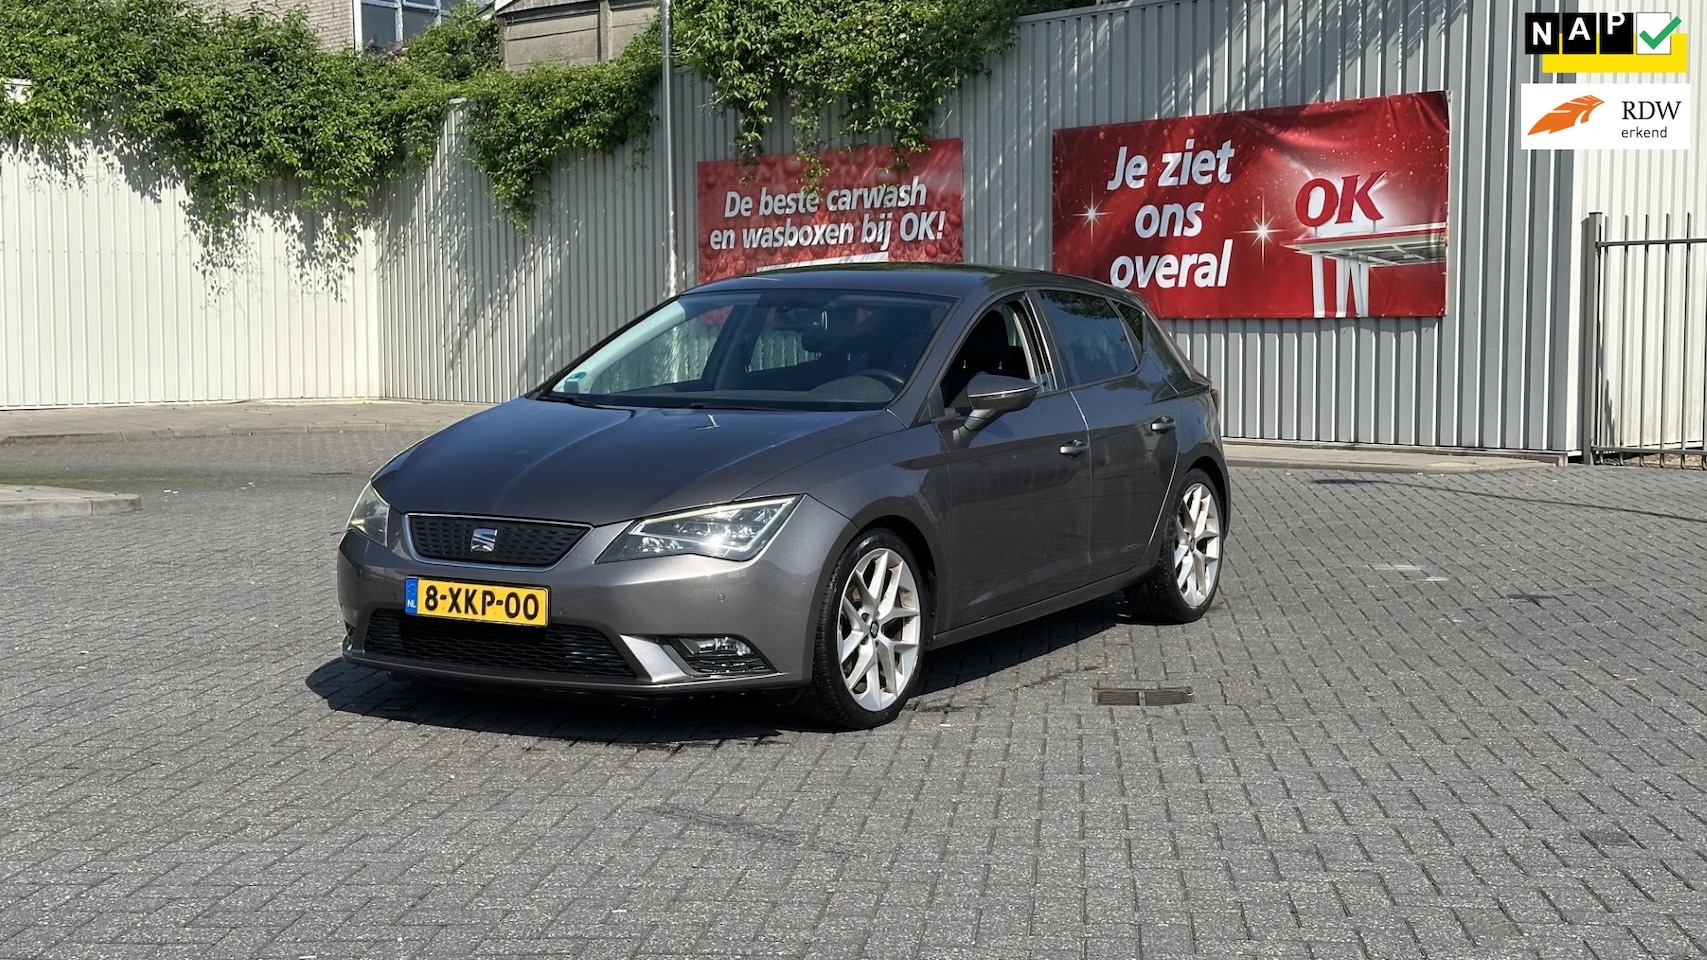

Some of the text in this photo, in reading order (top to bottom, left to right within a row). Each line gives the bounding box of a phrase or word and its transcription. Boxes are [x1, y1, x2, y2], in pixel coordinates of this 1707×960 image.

[1107, 138, 1234, 190] Je ziet
[724, 176, 926, 218] De beste carwash
[1295, 171, 1387, 227] OK
[709, 211, 946, 250] en wasboxen bij OK!
[1135, 201, 1204, 238] ons
[1110, 239, 1233, 289] overal
[407, 600, 416, 608] NL
[425, 585, 539, 620] 8-XKP-00
